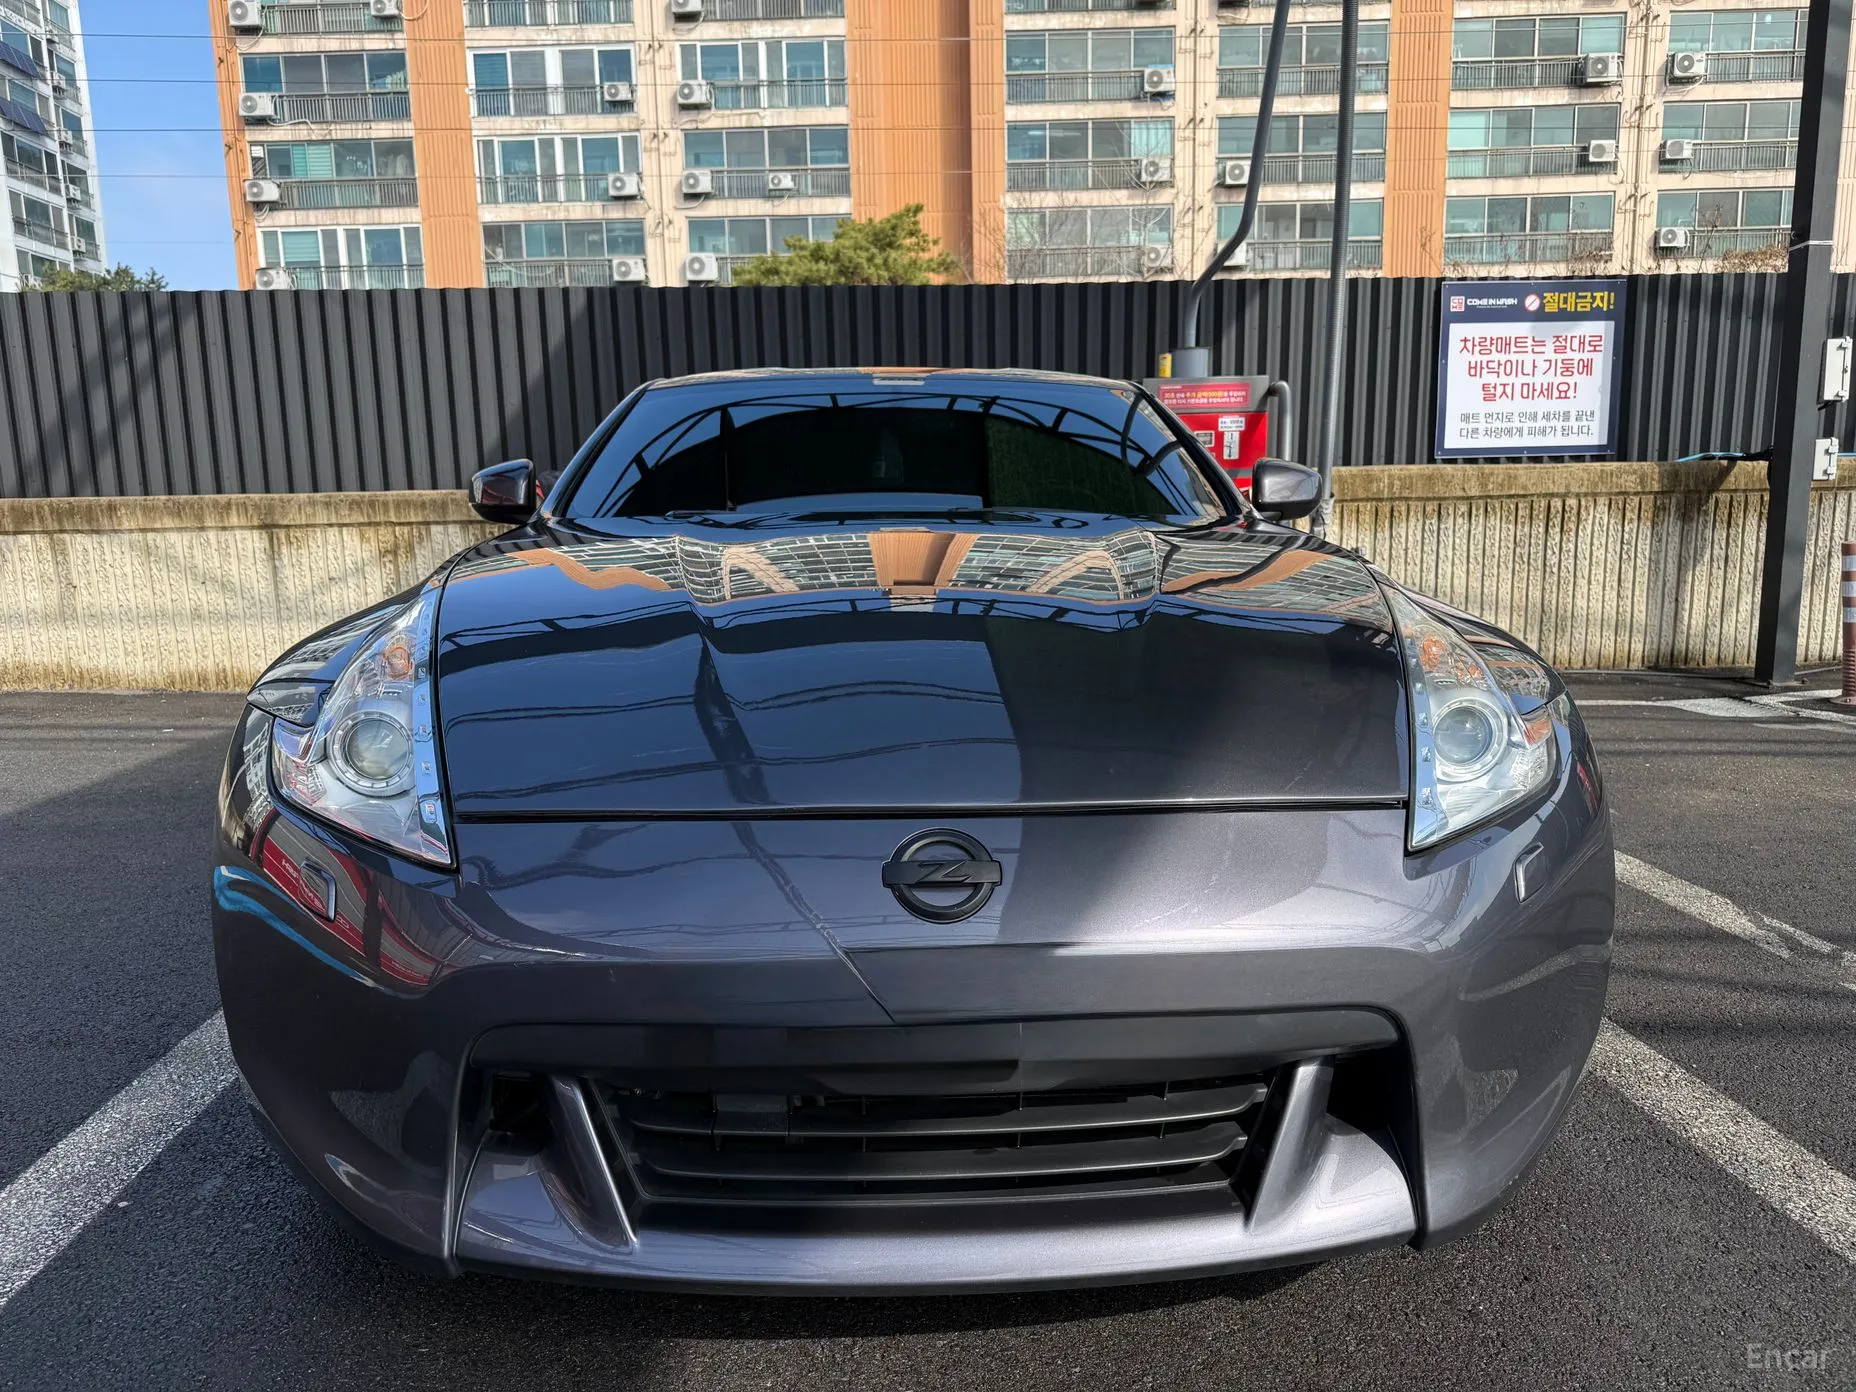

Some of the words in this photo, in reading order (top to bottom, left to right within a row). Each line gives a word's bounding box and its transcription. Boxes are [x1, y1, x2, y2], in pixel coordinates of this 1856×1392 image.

[1543, 291, 1615, 313] 절대금지!
[1459, 336, 1547, 356] 차량매트는
[1552, 334, 1604, 355] 절대로
[1468, 359, 1538, 379] 바닥이나
[1542, 358, 1594, 377] 기둥에
[1482, 382, 1515, 402] 털지
[1520, 381, 1578, 401] 마세요!
[1460, 412, 1481, 424] 매트
[1484, 412, 1515, 424] 먼지로
[1518, 411, 1538, 423] 인해
[1541, 410, 1571, 422] 세차를
[1575, 410, 1595, 422] 끝낸
[1459, 428, 1480, 440] 다른
[1483, 426, 1524, 440] 차량에게
[1527, 425, 1558, 438] 피해가
[1560, 425, 1594, 437] 됩니다.
